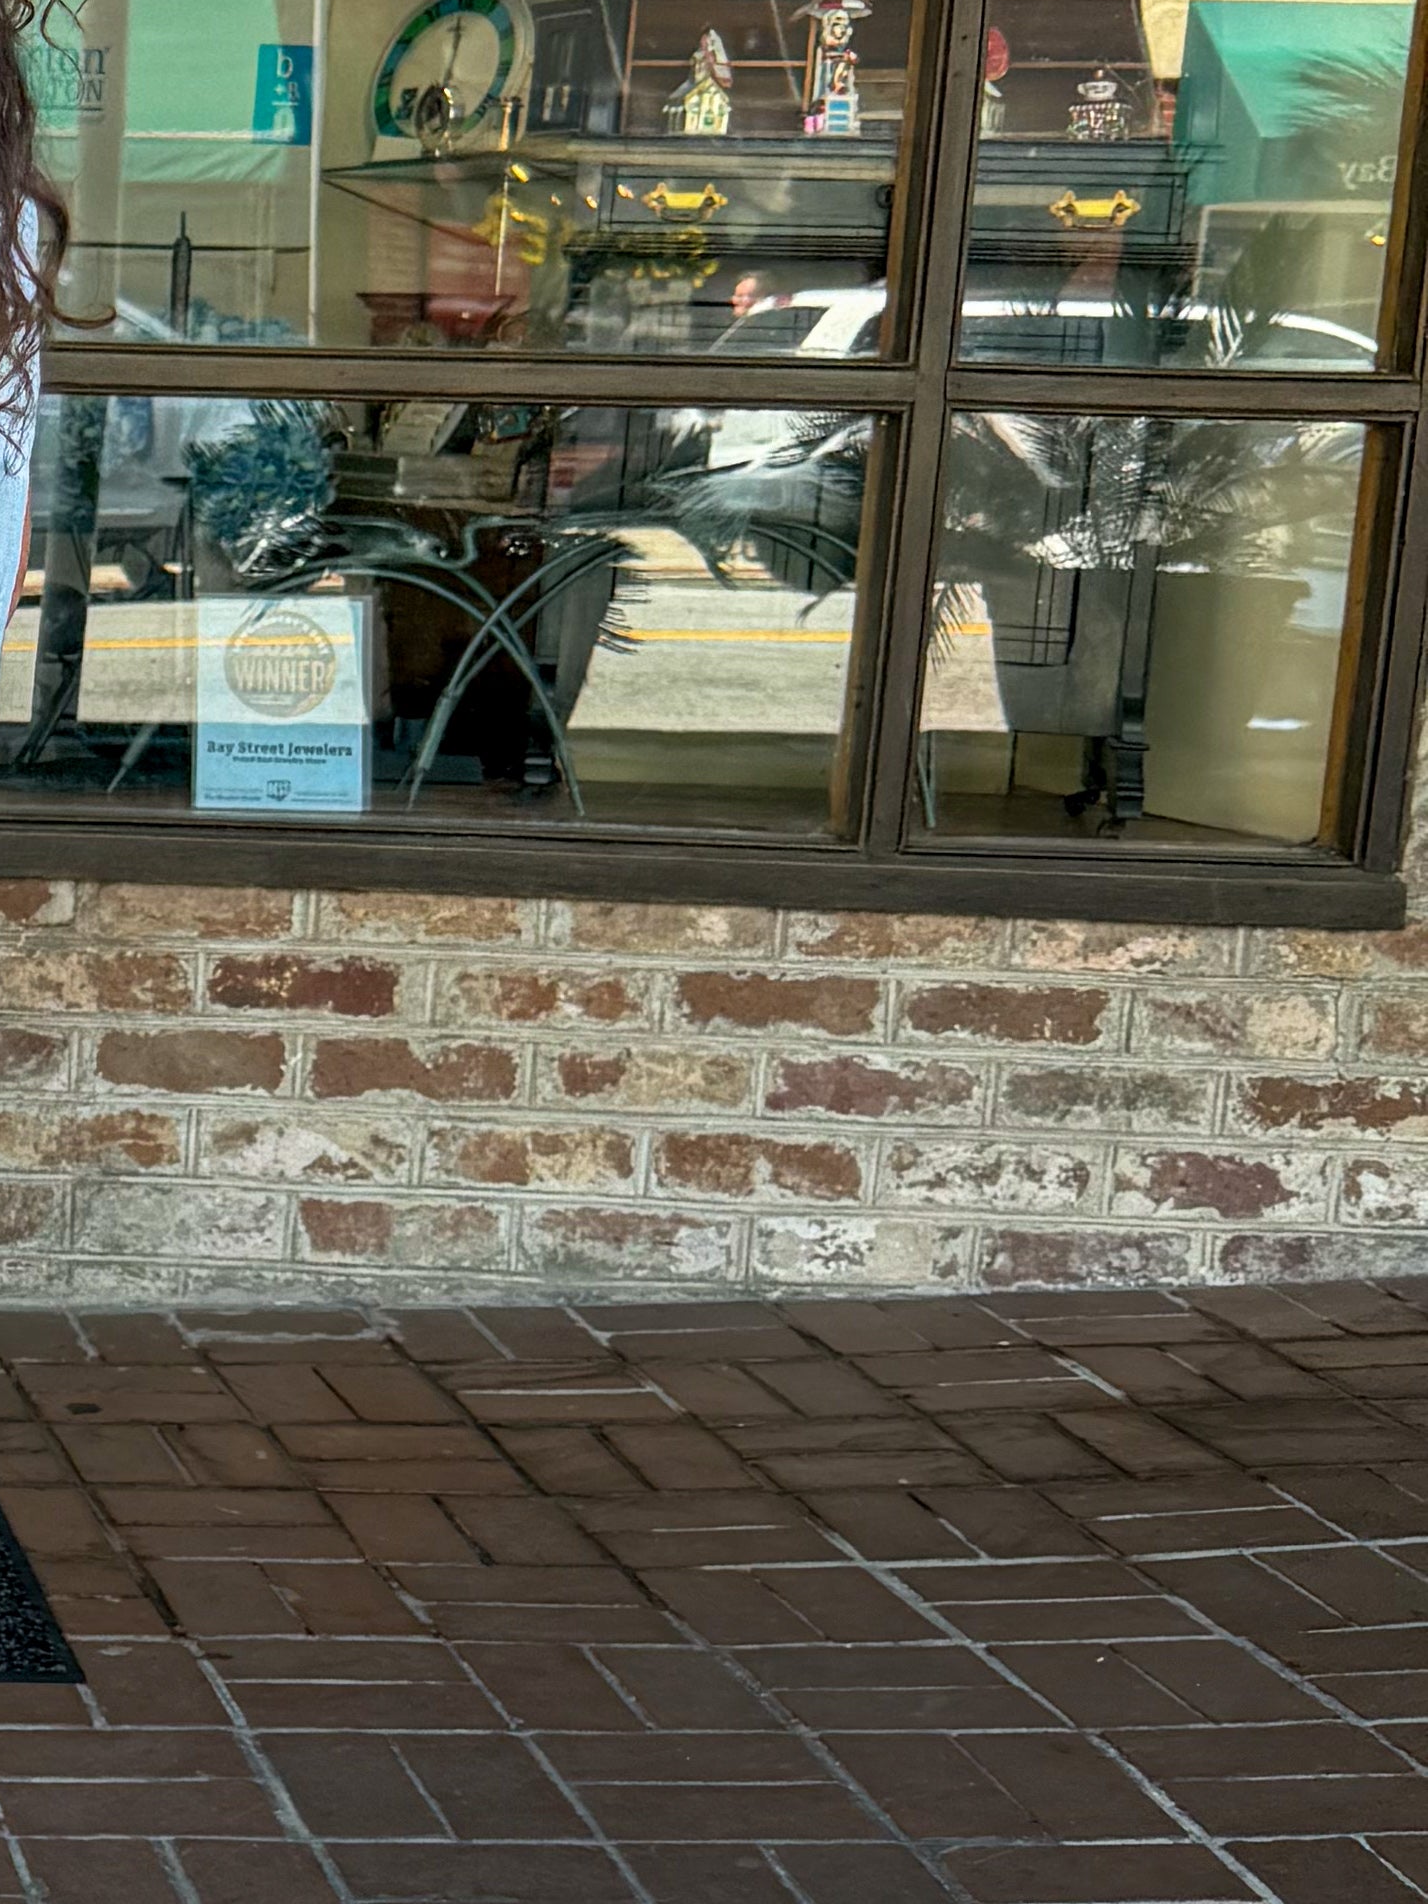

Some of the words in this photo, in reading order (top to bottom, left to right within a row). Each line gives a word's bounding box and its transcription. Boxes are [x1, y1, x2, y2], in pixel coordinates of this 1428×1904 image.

[234, 658, 326, 693] WINNER
[207, 740, 235, 757] Bay
[238, 741, 284, 756] Street
[288, 742, 353, 758] Jewelers
